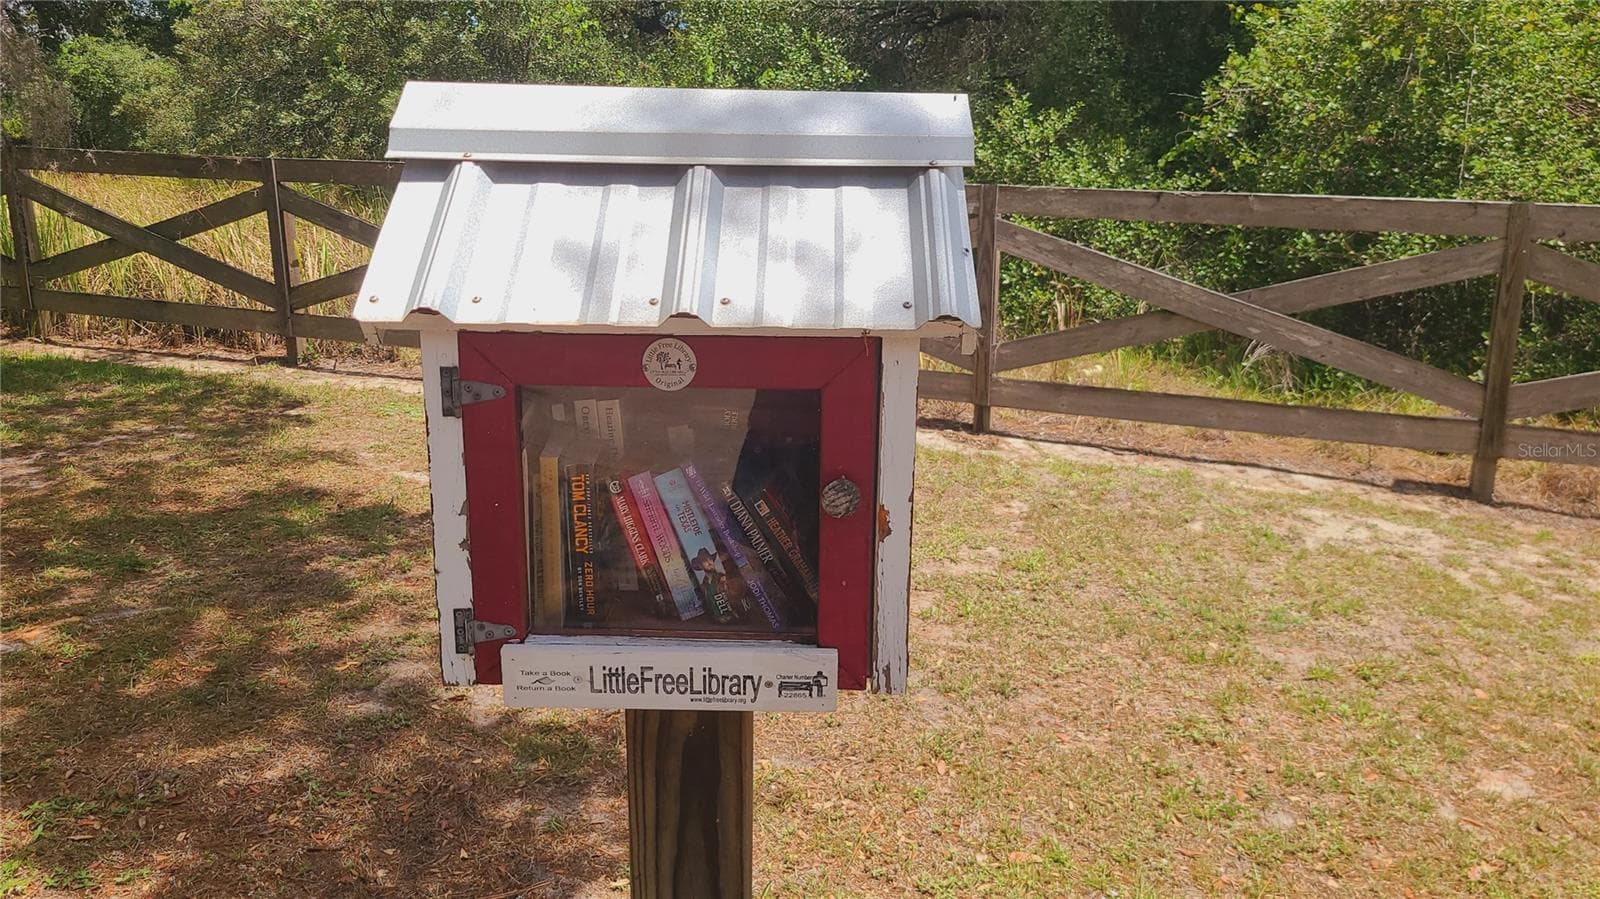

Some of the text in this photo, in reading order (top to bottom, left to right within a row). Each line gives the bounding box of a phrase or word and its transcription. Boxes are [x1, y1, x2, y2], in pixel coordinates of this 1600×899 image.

[646, 348, 658, 362] Little
[674, 343, 692, 362] Library
[656, 377, 684, 388] Original
[571, 474, 588, 554] TOM CLANCY
[614, 495, 649, 566] MARY HIGGINS CLARK
[676, 510, 692, 533] TEXAS
[680, 499, 702, 537] MISTLETOE
[727, 499, 755, 531] DIANA
[744, 527, 775, 564] PALMER
[655, 533, 673, 564] WOODS
[766, 516, 793, 551] HEATHER
[584, 561, 595, 615] ZERO HOUR
[713, 592, 729, 614] DELL
[745, 578, 761, 597] JODI
[755, 595, 780, 629] THOMAS
[589, 666, 762, 702] LittleFreeLibrary
